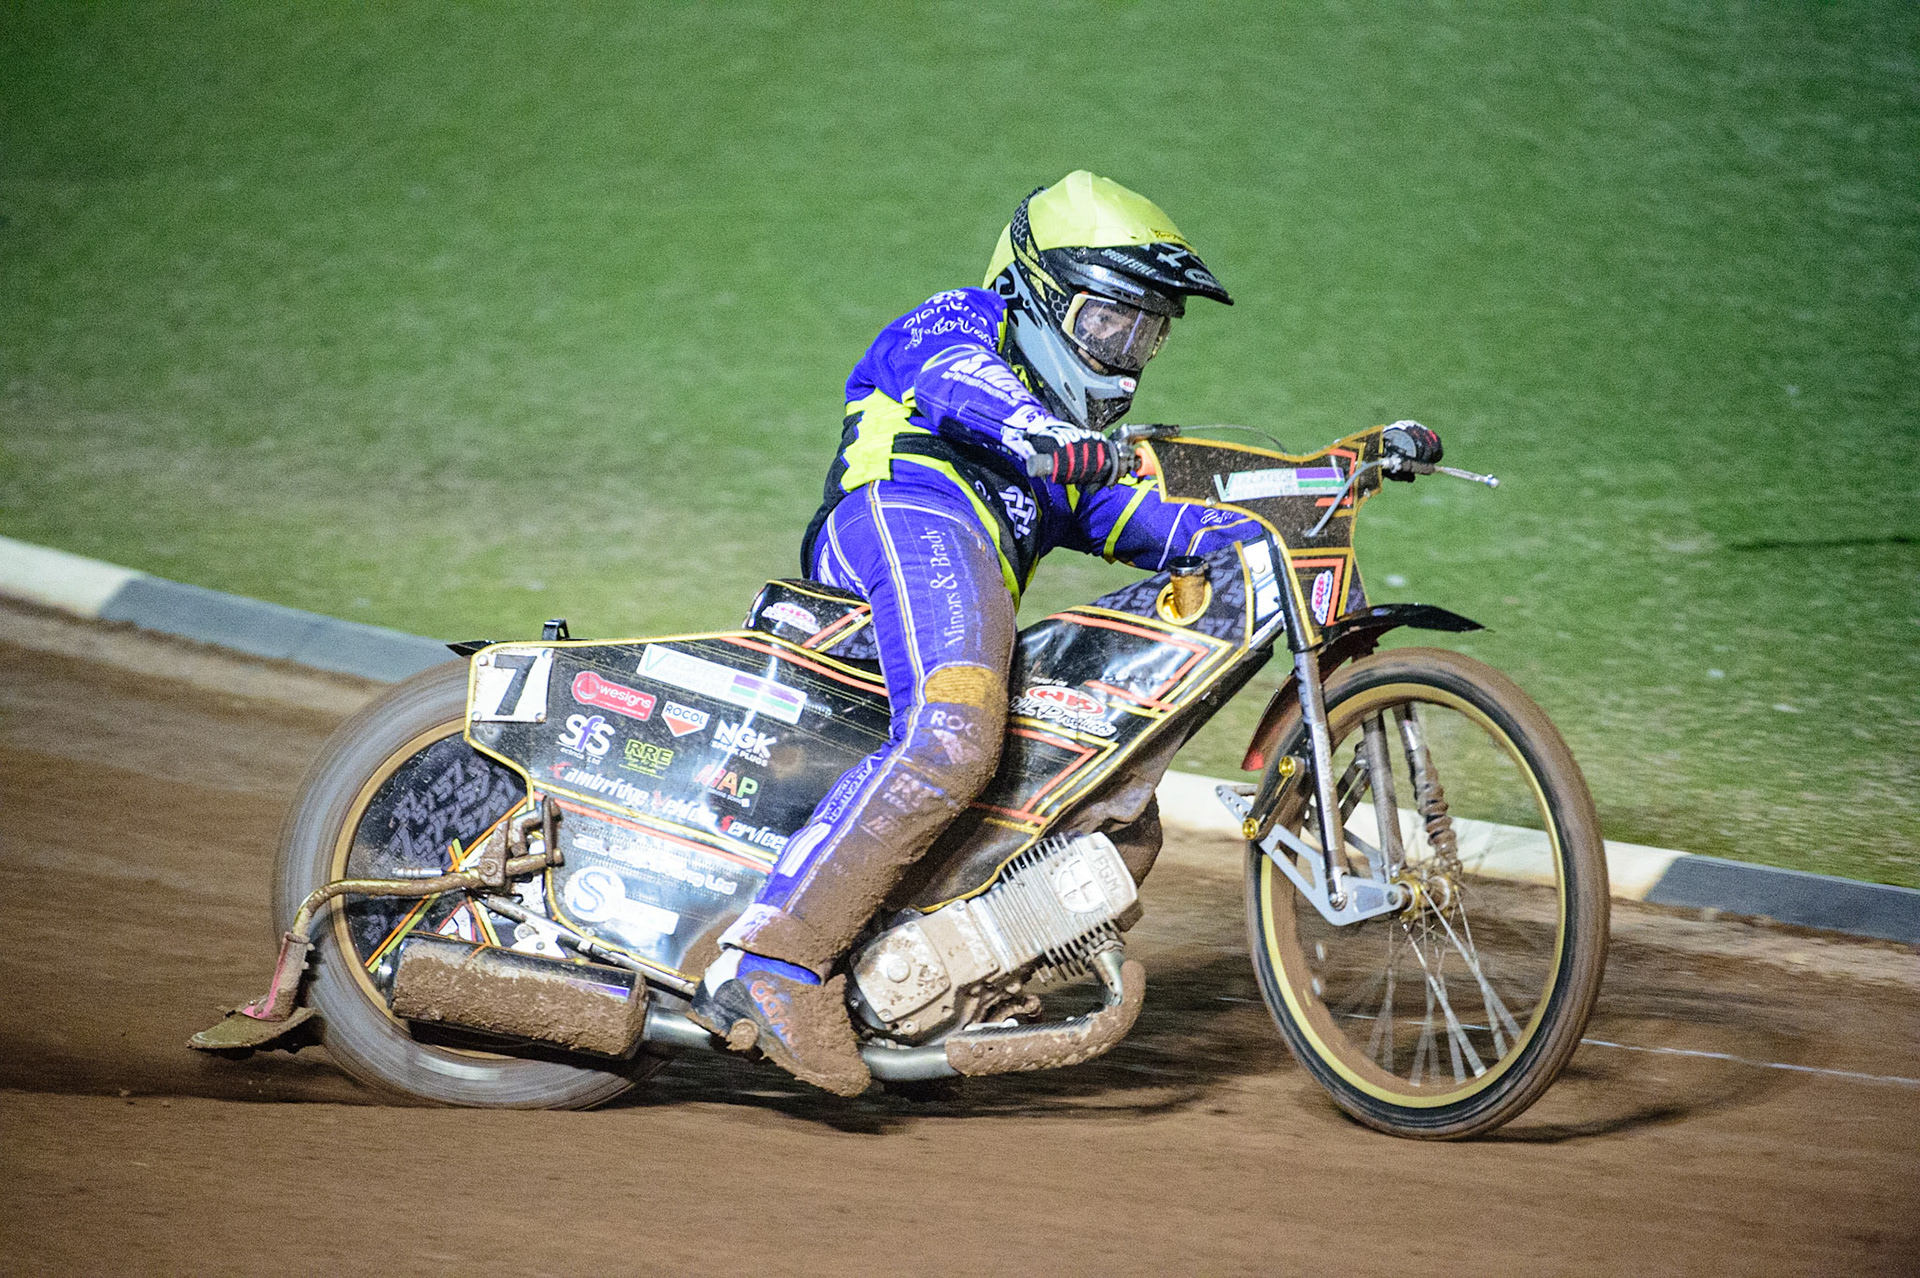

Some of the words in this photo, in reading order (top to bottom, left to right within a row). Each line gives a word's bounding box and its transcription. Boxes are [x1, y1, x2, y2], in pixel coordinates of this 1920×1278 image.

[494, 653, 537, 716] 7
[600, 684, 652, 709] wesigns
[664, 704, 704, 725] ROCOL
[624, 738, 675, 766] RRE
[713, 719, 778, 759] NGK
[711, 741, 738, 755] SPK
[739, 751, 768, 767] PLUGS
[548, 760, 650, 807] Cambridge
